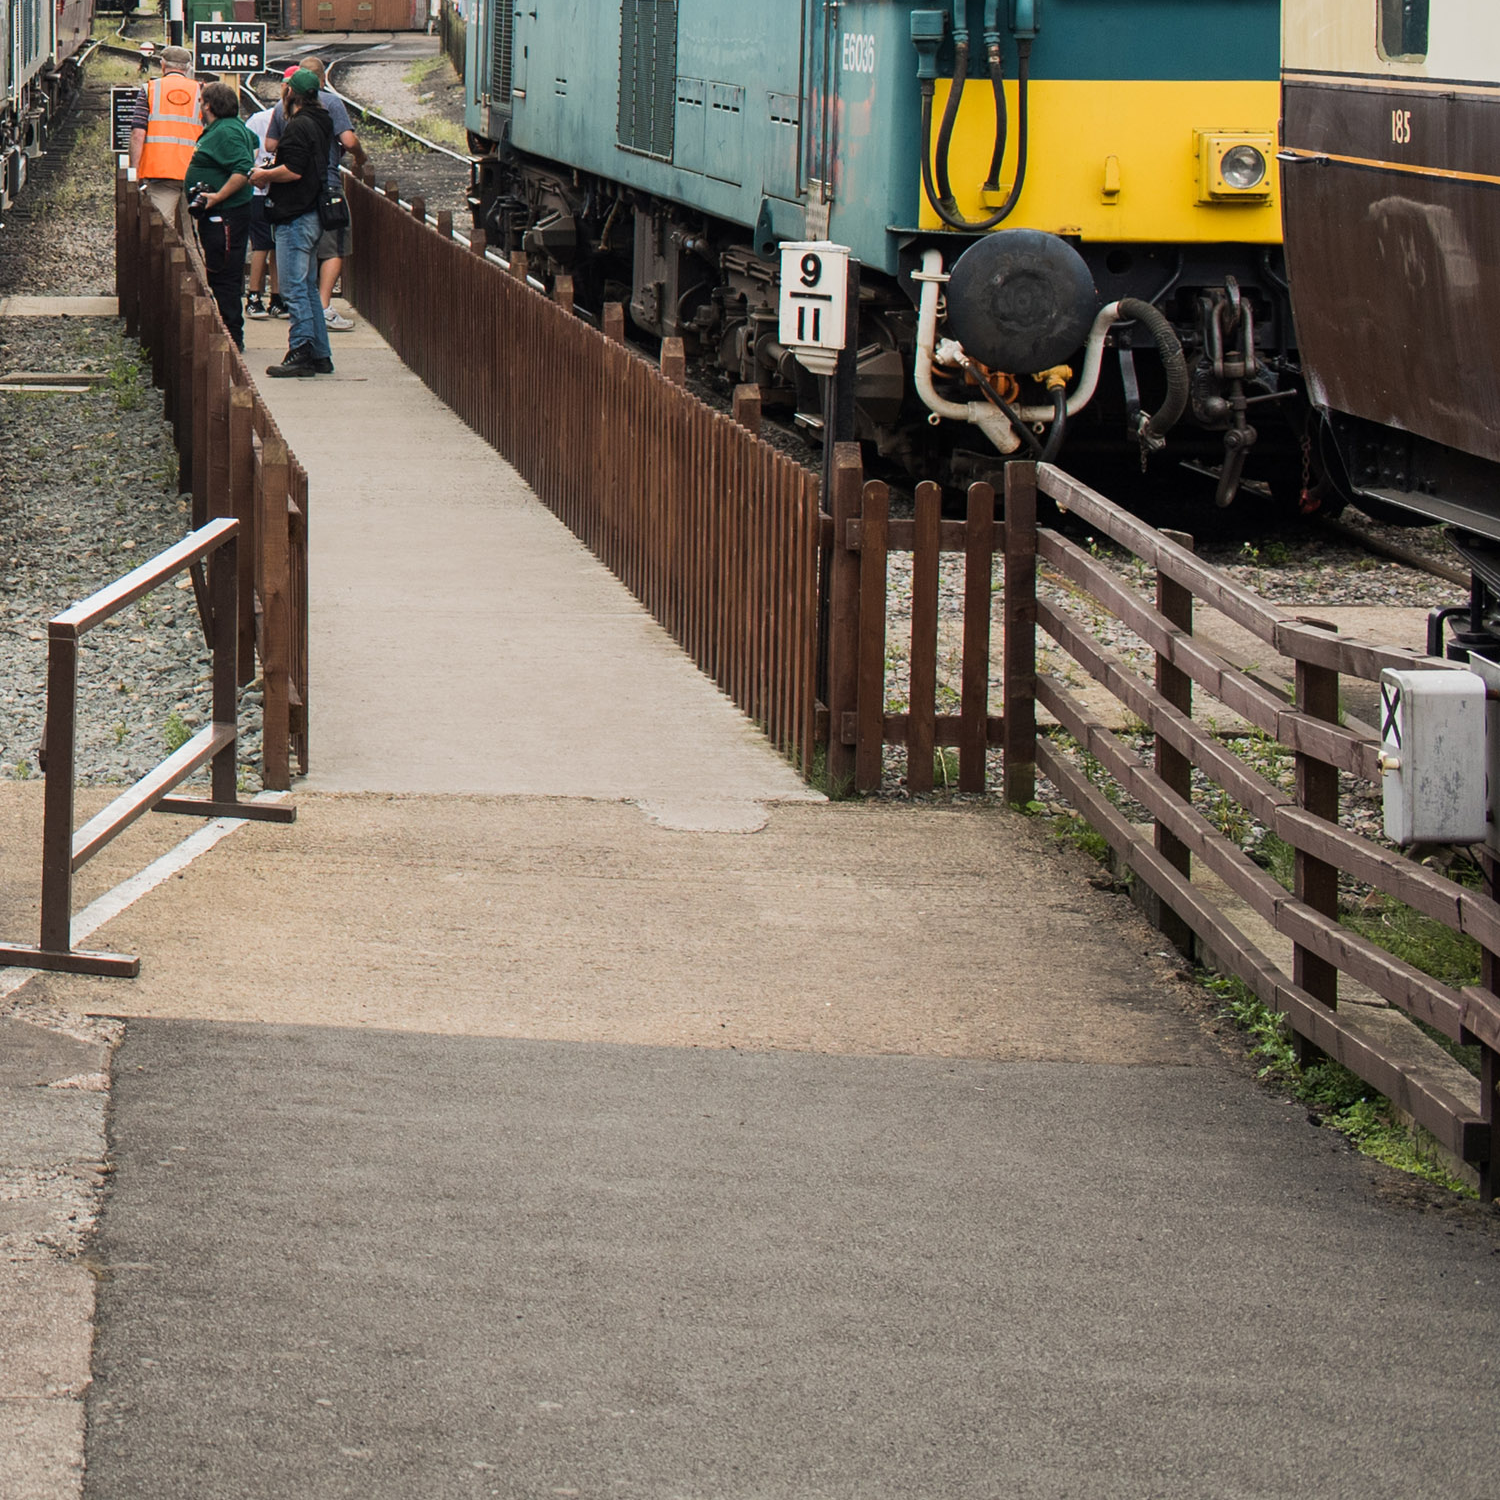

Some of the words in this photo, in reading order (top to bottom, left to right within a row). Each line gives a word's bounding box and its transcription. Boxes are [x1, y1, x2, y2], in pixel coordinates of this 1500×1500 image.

[200, 31, 260, 44] BEWARE
[842, 32, 875, 74] E6036
[201, 53, 259, 67] TRAINS
[1391, 109, 1411, 144] 185
[800, 252, 822, 288] 9
